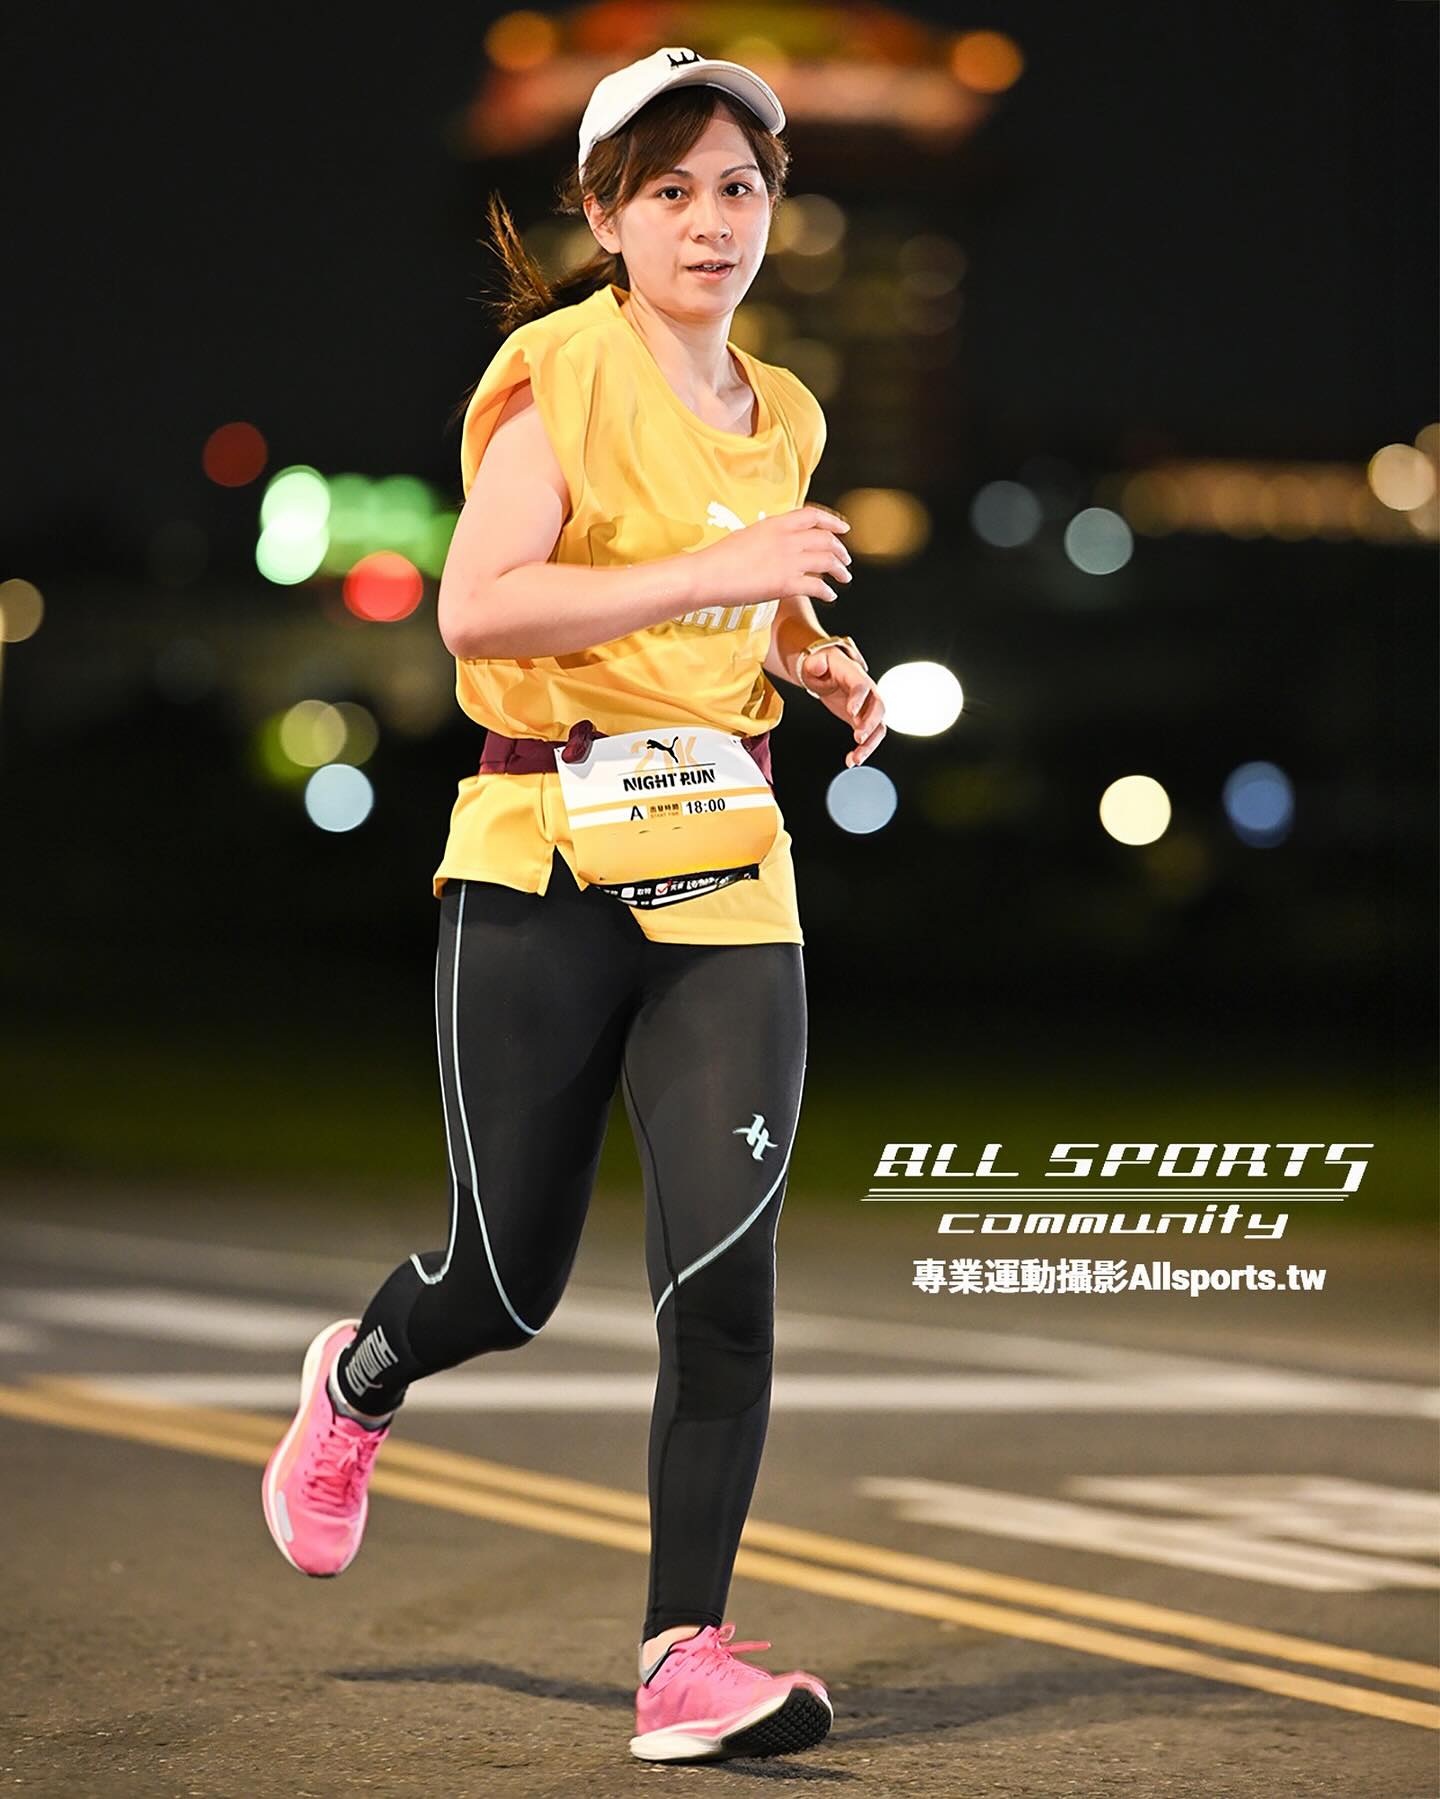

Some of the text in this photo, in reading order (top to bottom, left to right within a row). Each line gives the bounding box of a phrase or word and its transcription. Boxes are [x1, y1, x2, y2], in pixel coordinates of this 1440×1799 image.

[623, 769, 716, 792] NIGHT RUN
[630, 806, 643, 821] A
[686, 799, 726, 814] 18:00
